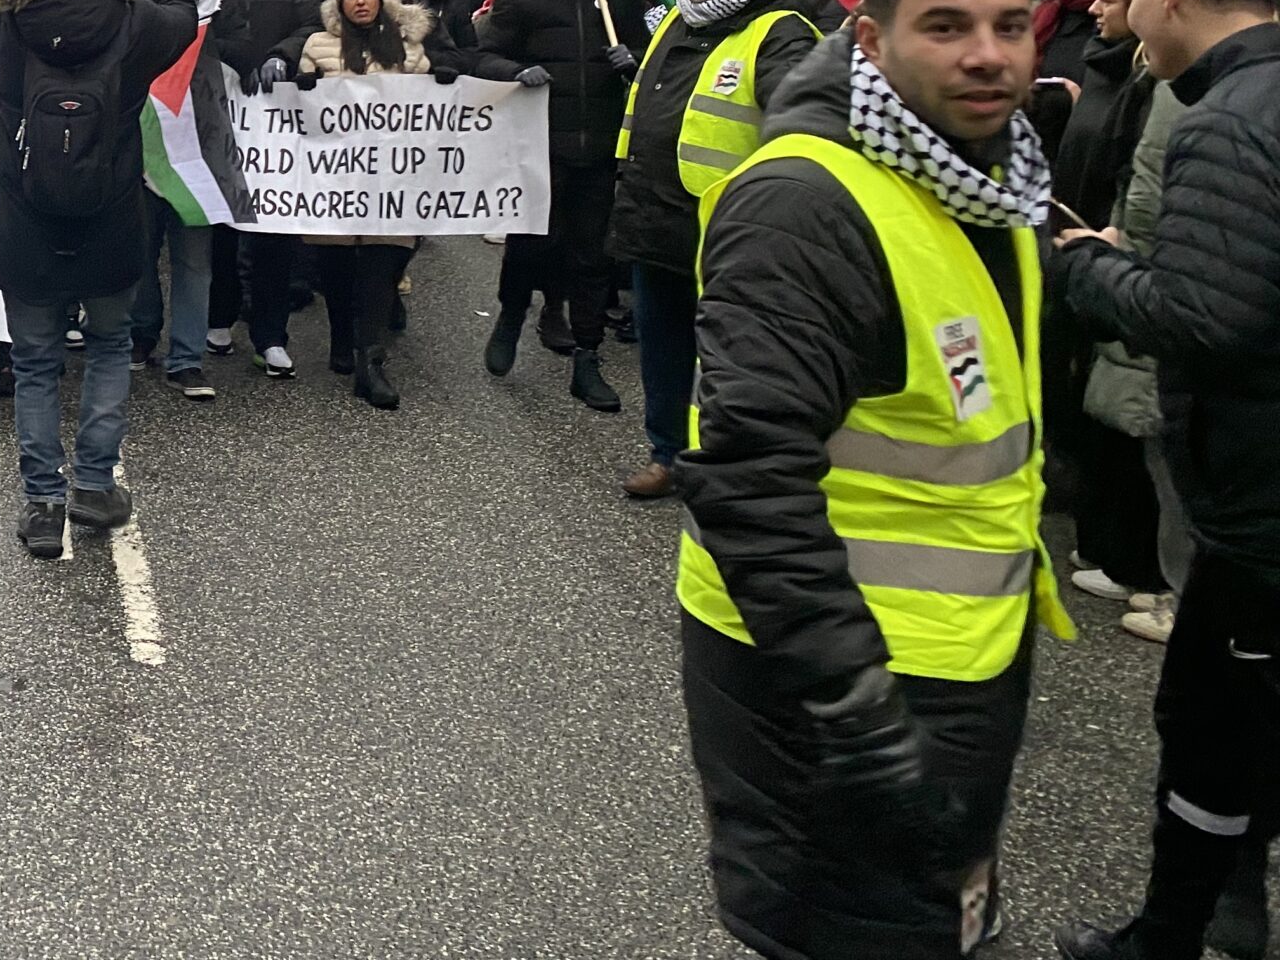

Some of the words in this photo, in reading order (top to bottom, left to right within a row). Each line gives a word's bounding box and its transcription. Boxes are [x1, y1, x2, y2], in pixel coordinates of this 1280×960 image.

[263, 108, 308, 136] THE
[320, 102, 494, 134] CONSCIENCES
[231, 146, 294, 175] ORLD
[307, 146, 379, 175] WAKE
[391, 146, 426, 175] UP
[437, 146, 465, 175] TO
[236, 187, 370, 220] ASSACRES
[379, 190, 404, 220] IN
